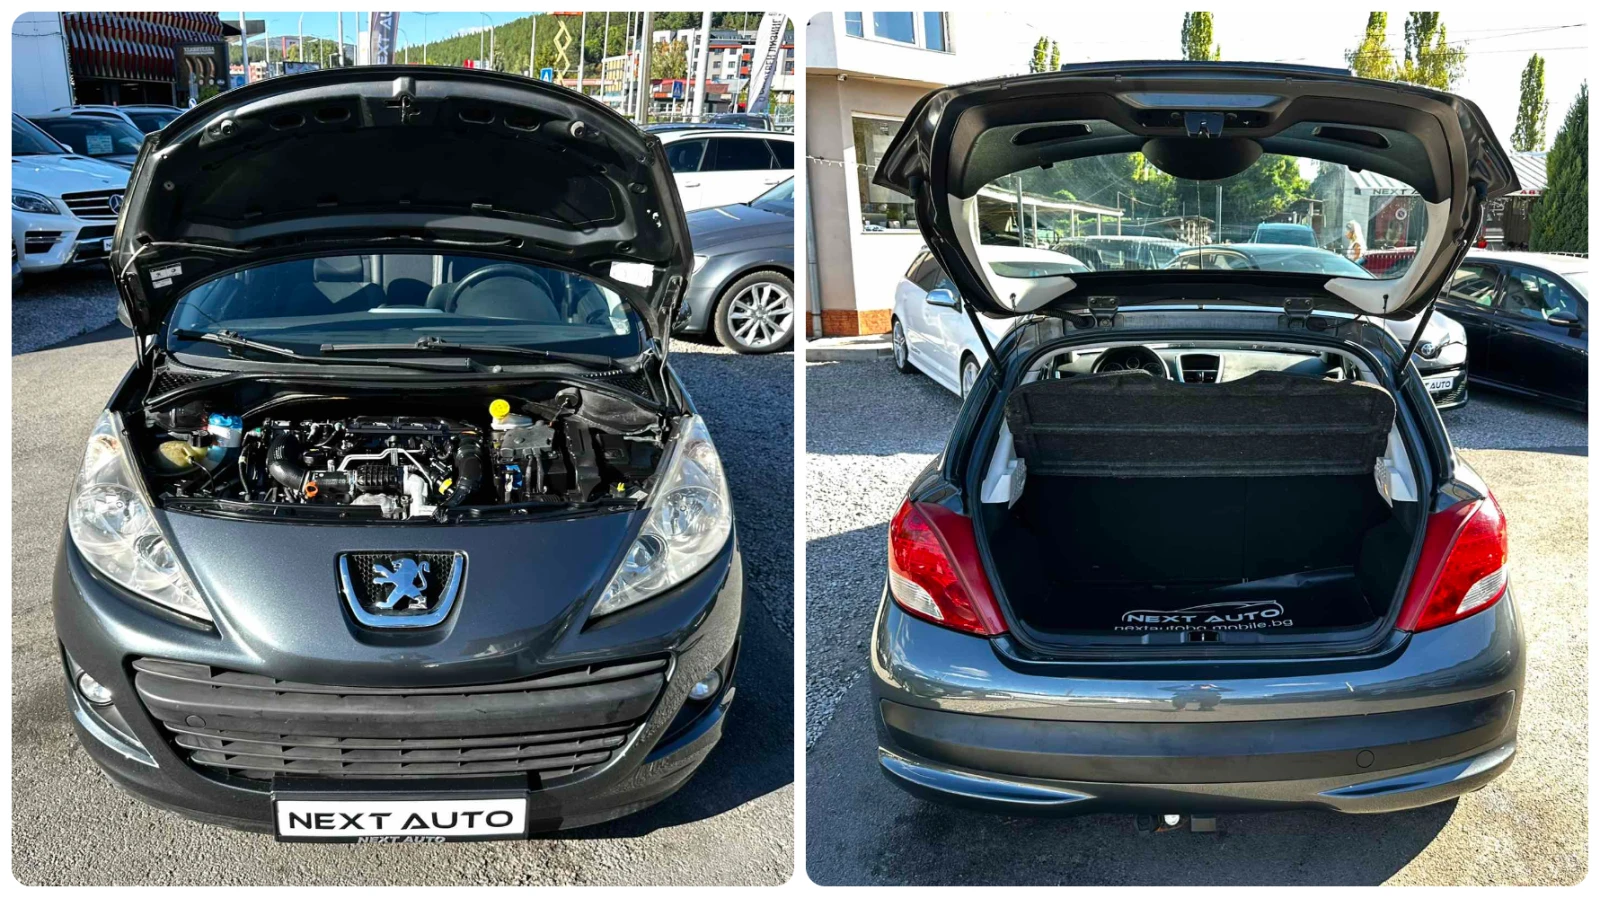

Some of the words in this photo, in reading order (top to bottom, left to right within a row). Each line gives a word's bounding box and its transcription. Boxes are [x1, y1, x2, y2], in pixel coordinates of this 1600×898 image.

[377, 33, 390, 65] EXT
[1430, 380, 1451, 389] AUTO
[1127, 614, 1197, 623] NEXT
[1204, 608, 1281, 623] AUTO
[289, 812, 393, 831] NEXT
[400, 810, 514, 831] AUTO
[357, 836, 400, 844] NEXT
[402, 836, 446, 844] AUTO
